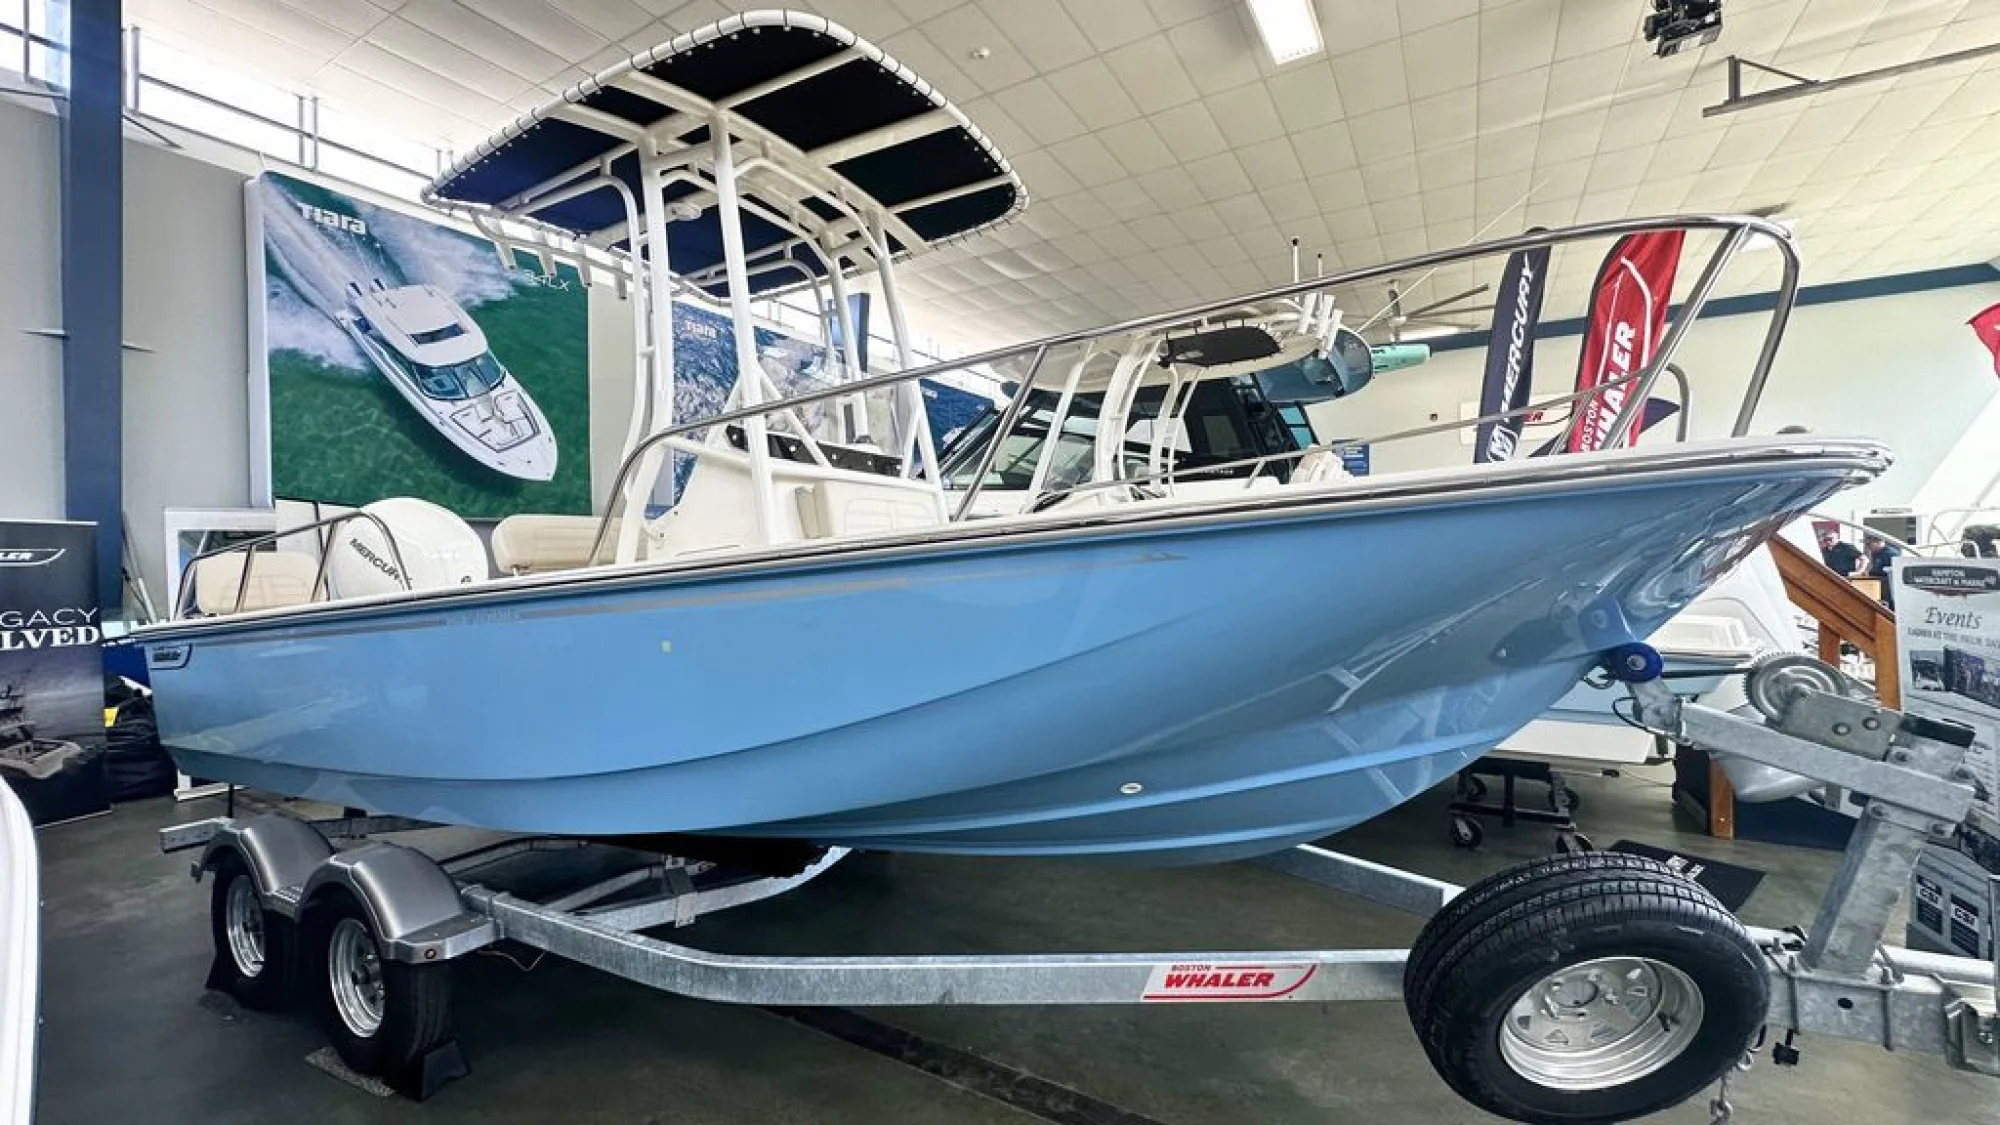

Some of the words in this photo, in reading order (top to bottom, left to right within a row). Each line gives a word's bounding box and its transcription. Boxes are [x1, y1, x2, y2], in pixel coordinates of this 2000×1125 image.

[1501, 252, 1534, 423] MERCURY
[0, 607, 98, 628] GACY
[1925, 606, 1983, 630] Events
[0, 626, 100, 651] LVED
[1171, 964, 1212, 972] BOSTON
[1165, 972, 1275, 989] WHALER
